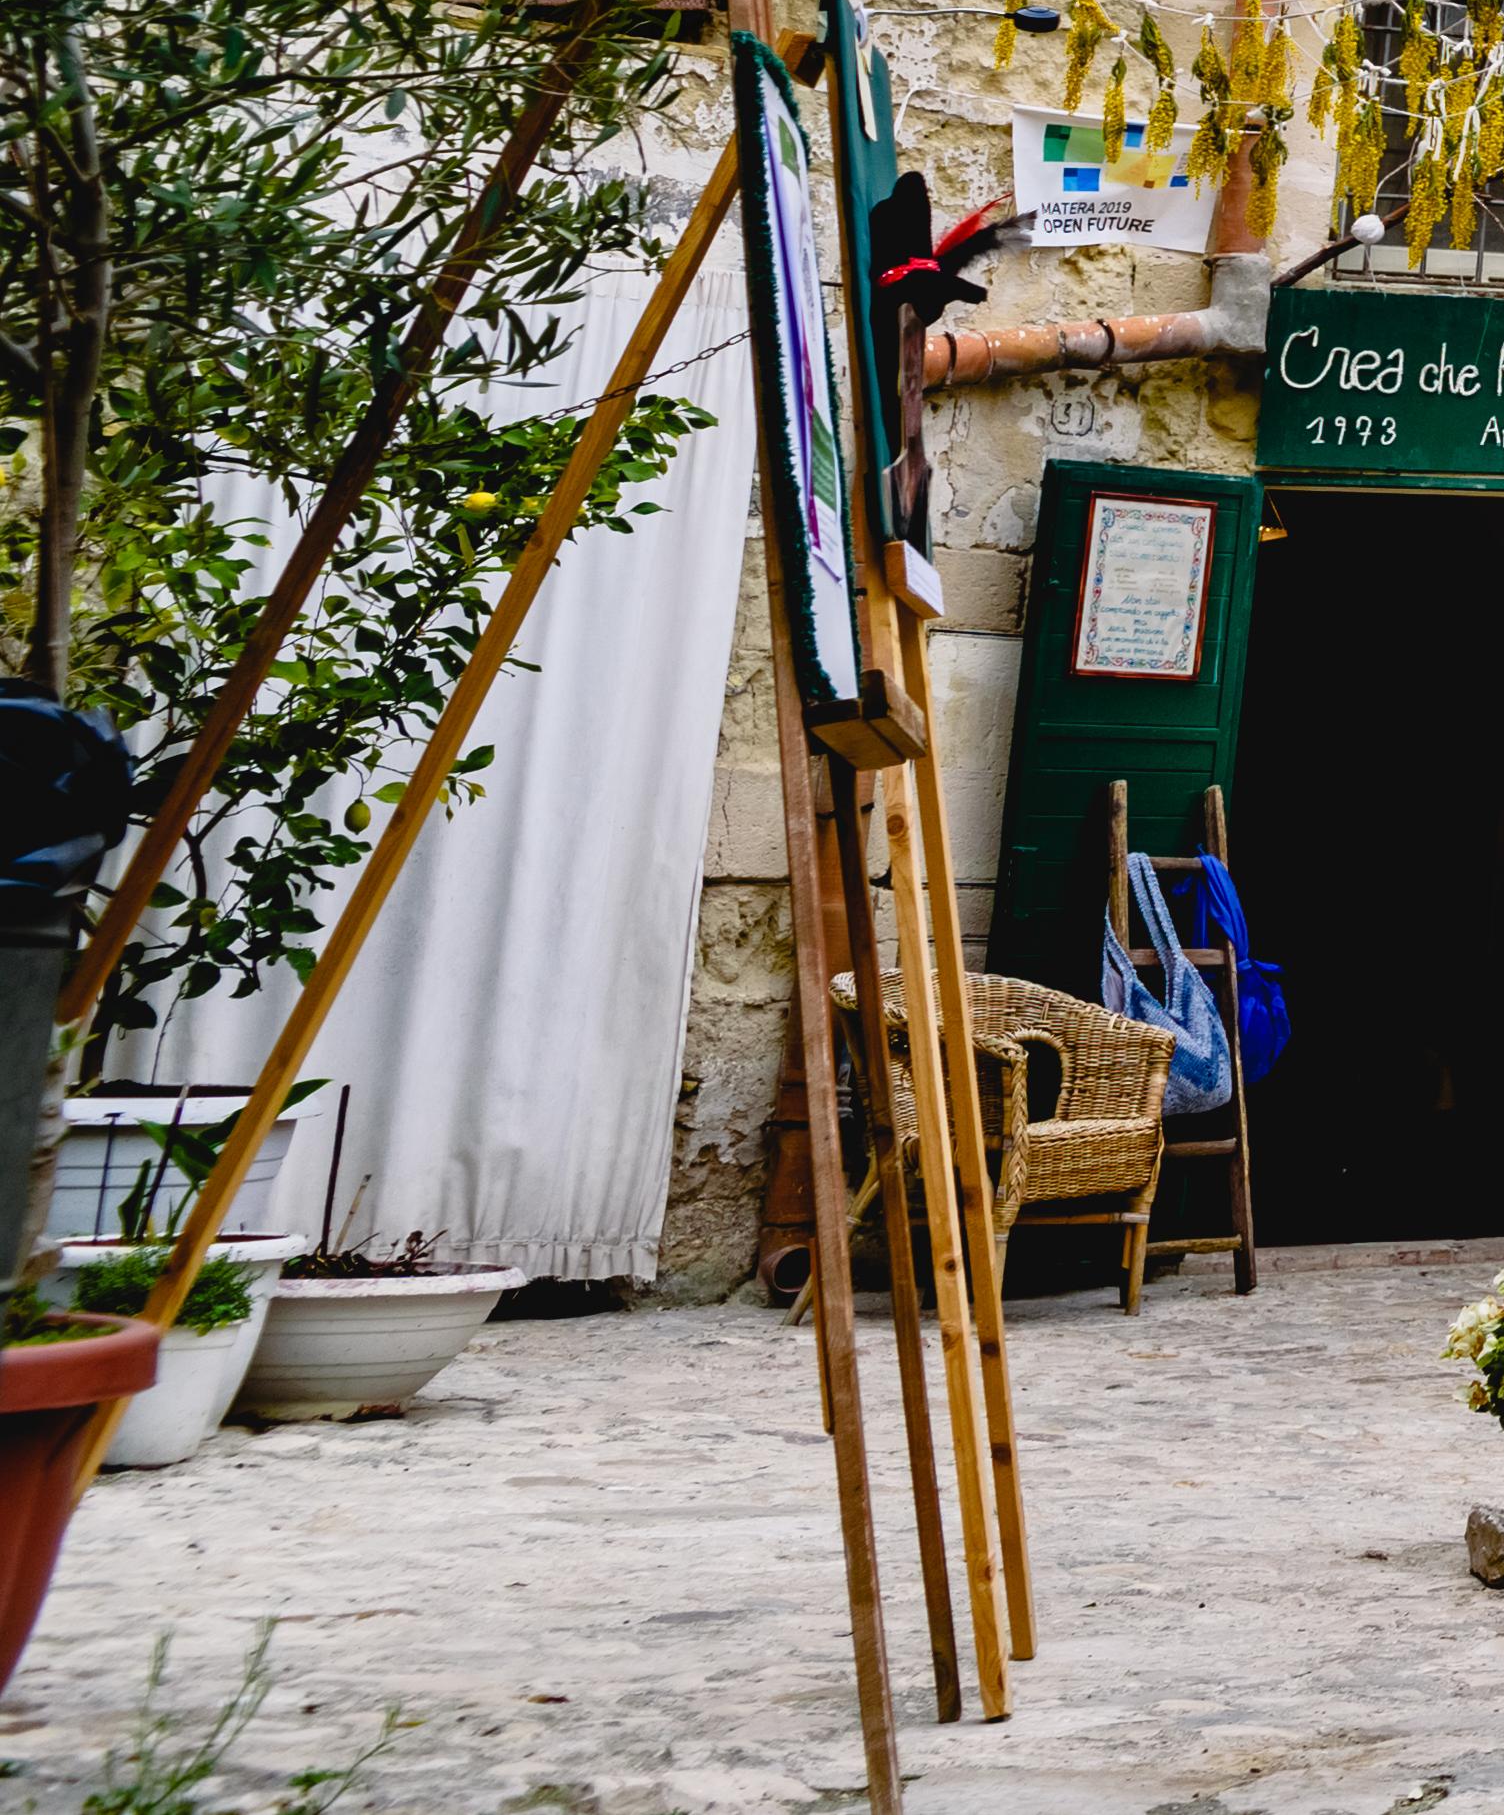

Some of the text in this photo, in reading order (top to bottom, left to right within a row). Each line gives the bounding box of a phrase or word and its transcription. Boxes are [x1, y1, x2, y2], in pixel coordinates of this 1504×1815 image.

[1041, 201, 1132, 215] MATERA 2019
[1043, 216, 1156, 234] OPEN FUTURE
[1280, 326, 1405, 394] Crea
[1419, 342, 1481, 397] che
[1306, 416, 1398, 446] 1973
